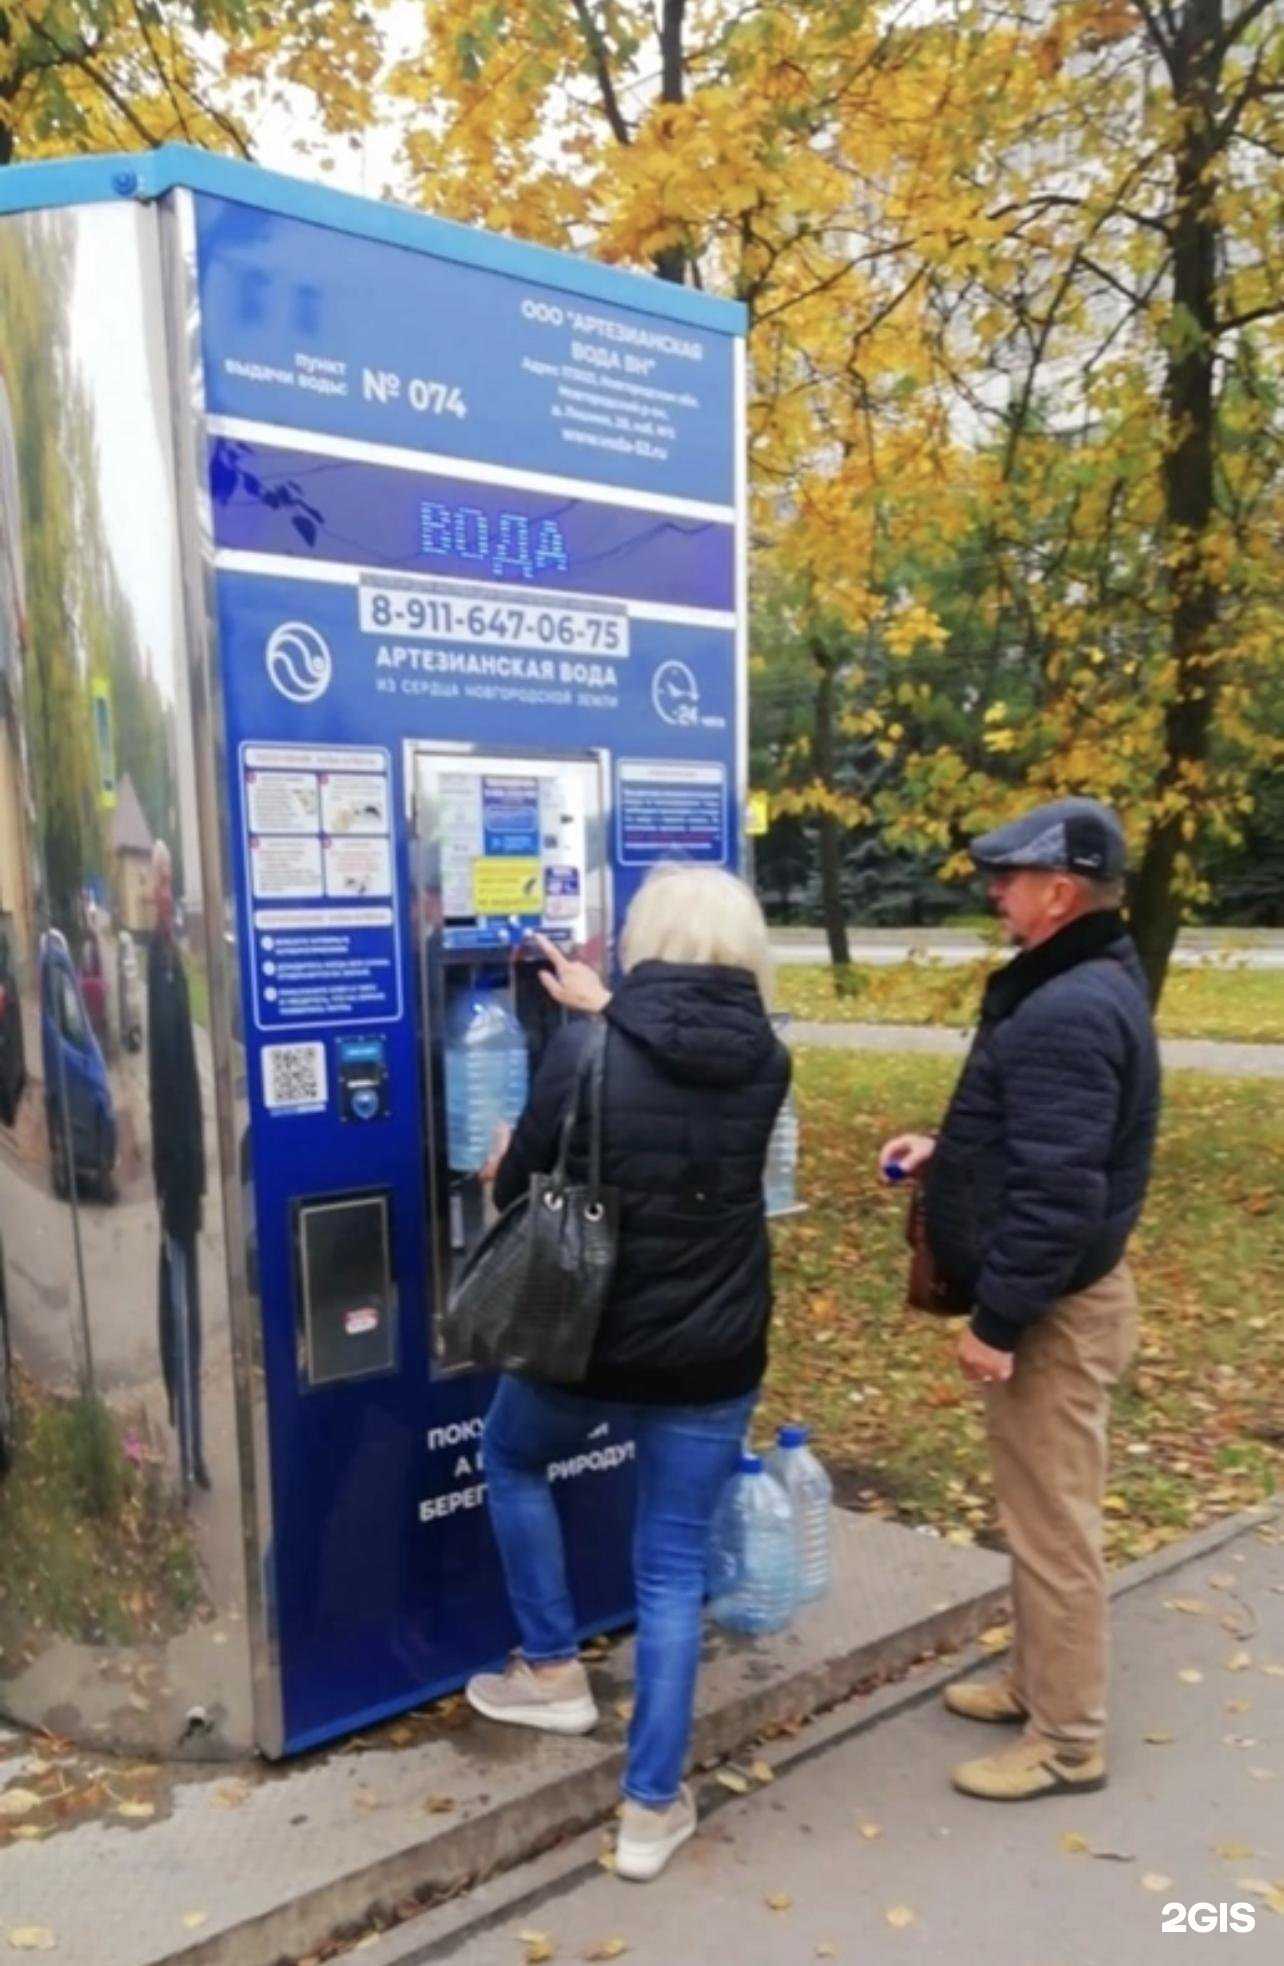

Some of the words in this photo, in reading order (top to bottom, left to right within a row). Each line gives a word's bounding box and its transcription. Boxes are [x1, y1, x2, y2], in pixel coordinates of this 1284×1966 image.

[521, 299, 564, 327] ООО
[570, 340, 622, 370] ВОДА
[362, 367, 401, 405] №
[408, 378, 467, 420] 074
[419, 501, 568, 578] ВОДА
[372, 593, 621, 650] 8-911-647-06-75
[376, 645, 554, 681] АРТЕЗИАНСКАЯ
[558, 661, 619, 688] ВОДА
